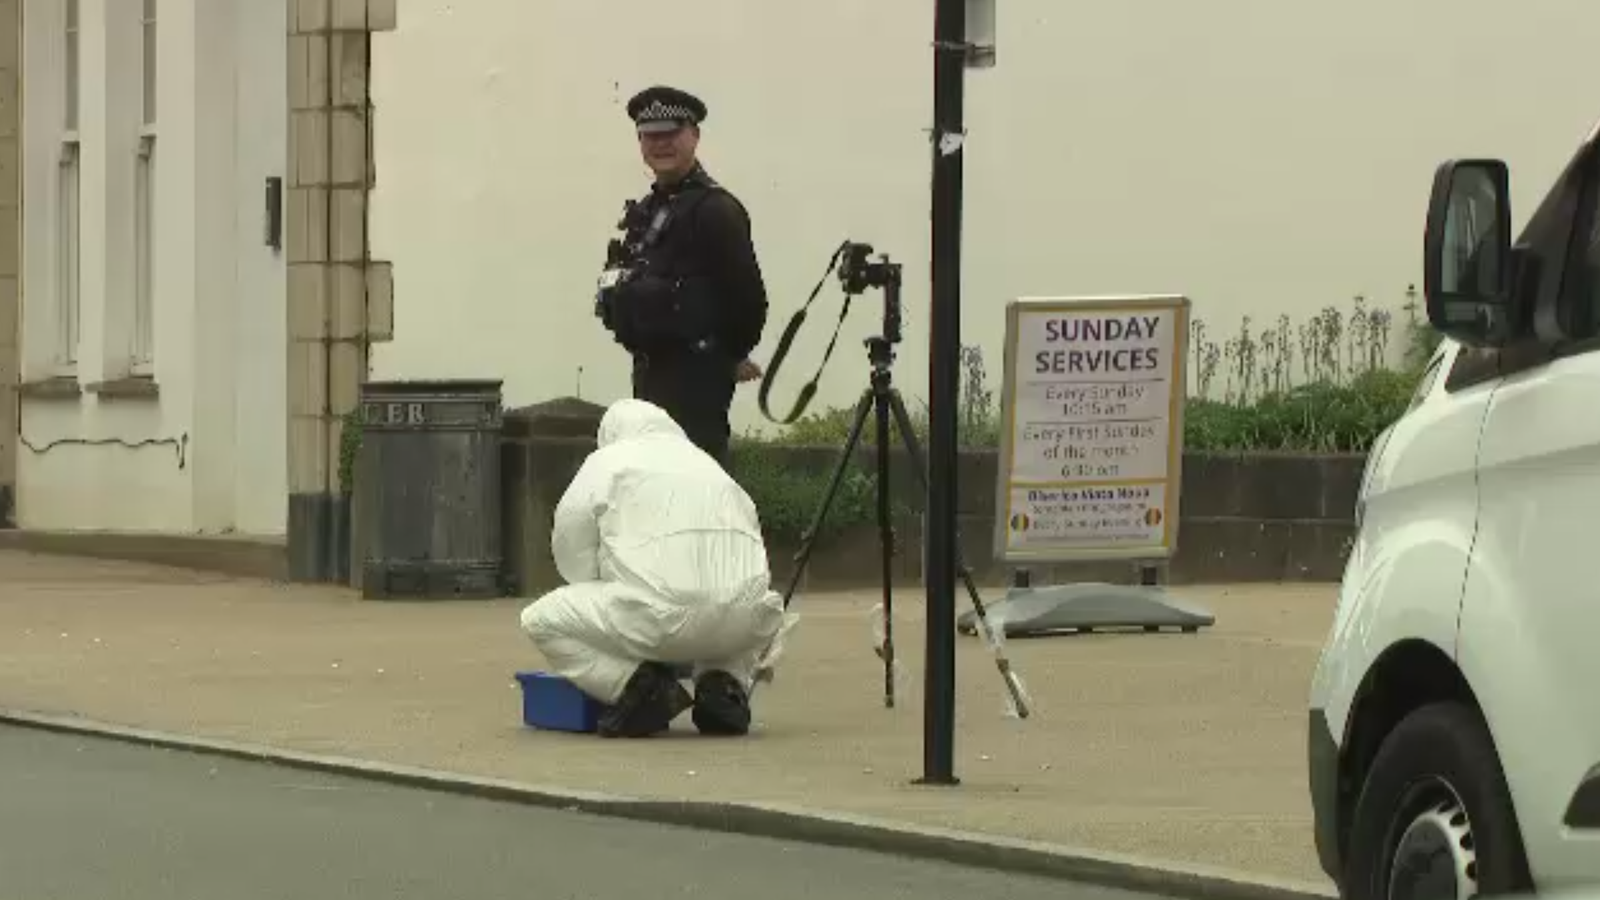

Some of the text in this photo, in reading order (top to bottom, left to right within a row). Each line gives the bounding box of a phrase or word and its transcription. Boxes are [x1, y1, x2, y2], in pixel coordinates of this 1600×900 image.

[1046, 316, 1160, 342] SUNDAY
[1036, 348, 1159, 374] SERVICES
[1046, 385, 1144, 401] Every Sunday
[1024, 425, 1155, 443] Every First Sunday
[1043, 444, 1060, 459] of
[1064, 444, 1086, 459] the
